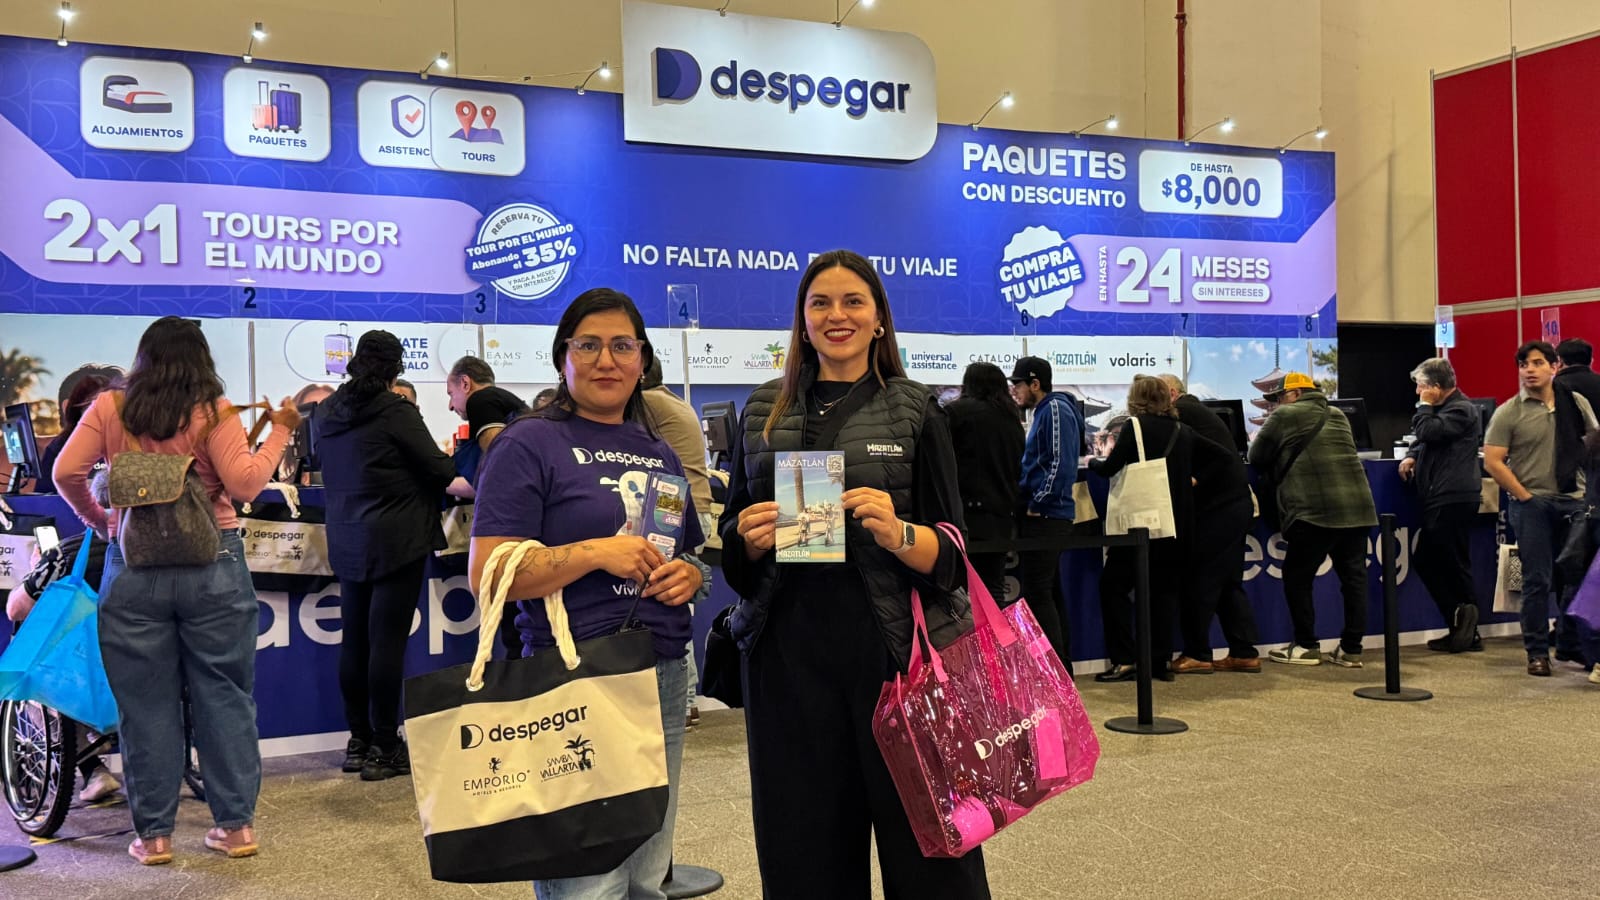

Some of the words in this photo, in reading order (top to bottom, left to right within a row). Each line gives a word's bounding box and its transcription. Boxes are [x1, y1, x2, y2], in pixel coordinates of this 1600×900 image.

[711, 60, 911, 118] despegar
[91, 123, 184, 139] ALOJAMIENTOS
[248, 134, 308, 149] PAQUETES
[462, 151, 496, 163] TOURS
[962, 142, 1127, 181] PAQUETES
[1190, 163, 1202, 172] DE
[1204, 163, 1233, 174] HASTA
[962, 181, 1006, 202] CON
[1010, 186, 1127, 209] DESCUENTO
[1161, 173, 1262, 210] $8,000
[42, 198, 180, 264] 2x1
[203, 210, 322, 242] TOURS
[329, 220, 399, 246] POR
[491, 212, 530, 236] RESERVA
[531, 214, 545, 225] TU
[466, 243, 498, 257] TOUR
[498, 237, 521, 250] POR
[521, 233, 536, 244] EL
[536, 223, 574, 241] MUNDO
[205, 241, 247, 268] EL
[254, 245, 382, 274] MUNDO
[472, 253, 520, 270] Abonando
[521, 236, 577, 268] 35%
[623, 243, 660, 266] NO
[665, 246, 732, 269] FALTA
[737, 249, 799, 271] NADA
[868, 255, 896, 276] TU
[901, 257, 958, 277] VIAJE
[1000, 245, 1076, 283] COMPRA
[1099, 245, 1107, 284] HASTA
[1116, 245, 1182, 303] 24
[1191, 255, 1271, 280] MESES
[512, 283, 524, 291] SIN
[1001, 278, 1028, 303] TU
[1028, 263, 1083, 294] VIAJE
[1198, 287, 1213, 296] SIN
[1215, 287, 1264, 299] INTERESES
[243, 287, 257, 309] 2
[475, 292, 486, 315] 3
[1099, 286, 1107, 301] EN
[678, 302, 689, 321] 4
[1020, 309, 1029, 327] 6
[1181, 313, 1189, 329] 7
[1304, 315, 1313, 332] 8
[1441, 321, 1448, 335] 9
[1544, 322, 1557, 336] 10
[911, 352, 952, 362] universal
[911, 361, 957, 370] assistance
[1109, 352, 1156, 367] volaris
[595, 448, 664, 469] despegar
[253, 530, 304, 541] despegar
[488, 705, 588, 742] despegar
[995, 705, 1049, 748] despegar
[540, 762, 579, 779] VALLARTA
[546, 754, 574, 767] SAMBA
[463, 771, 527, 791] EMPORIO
